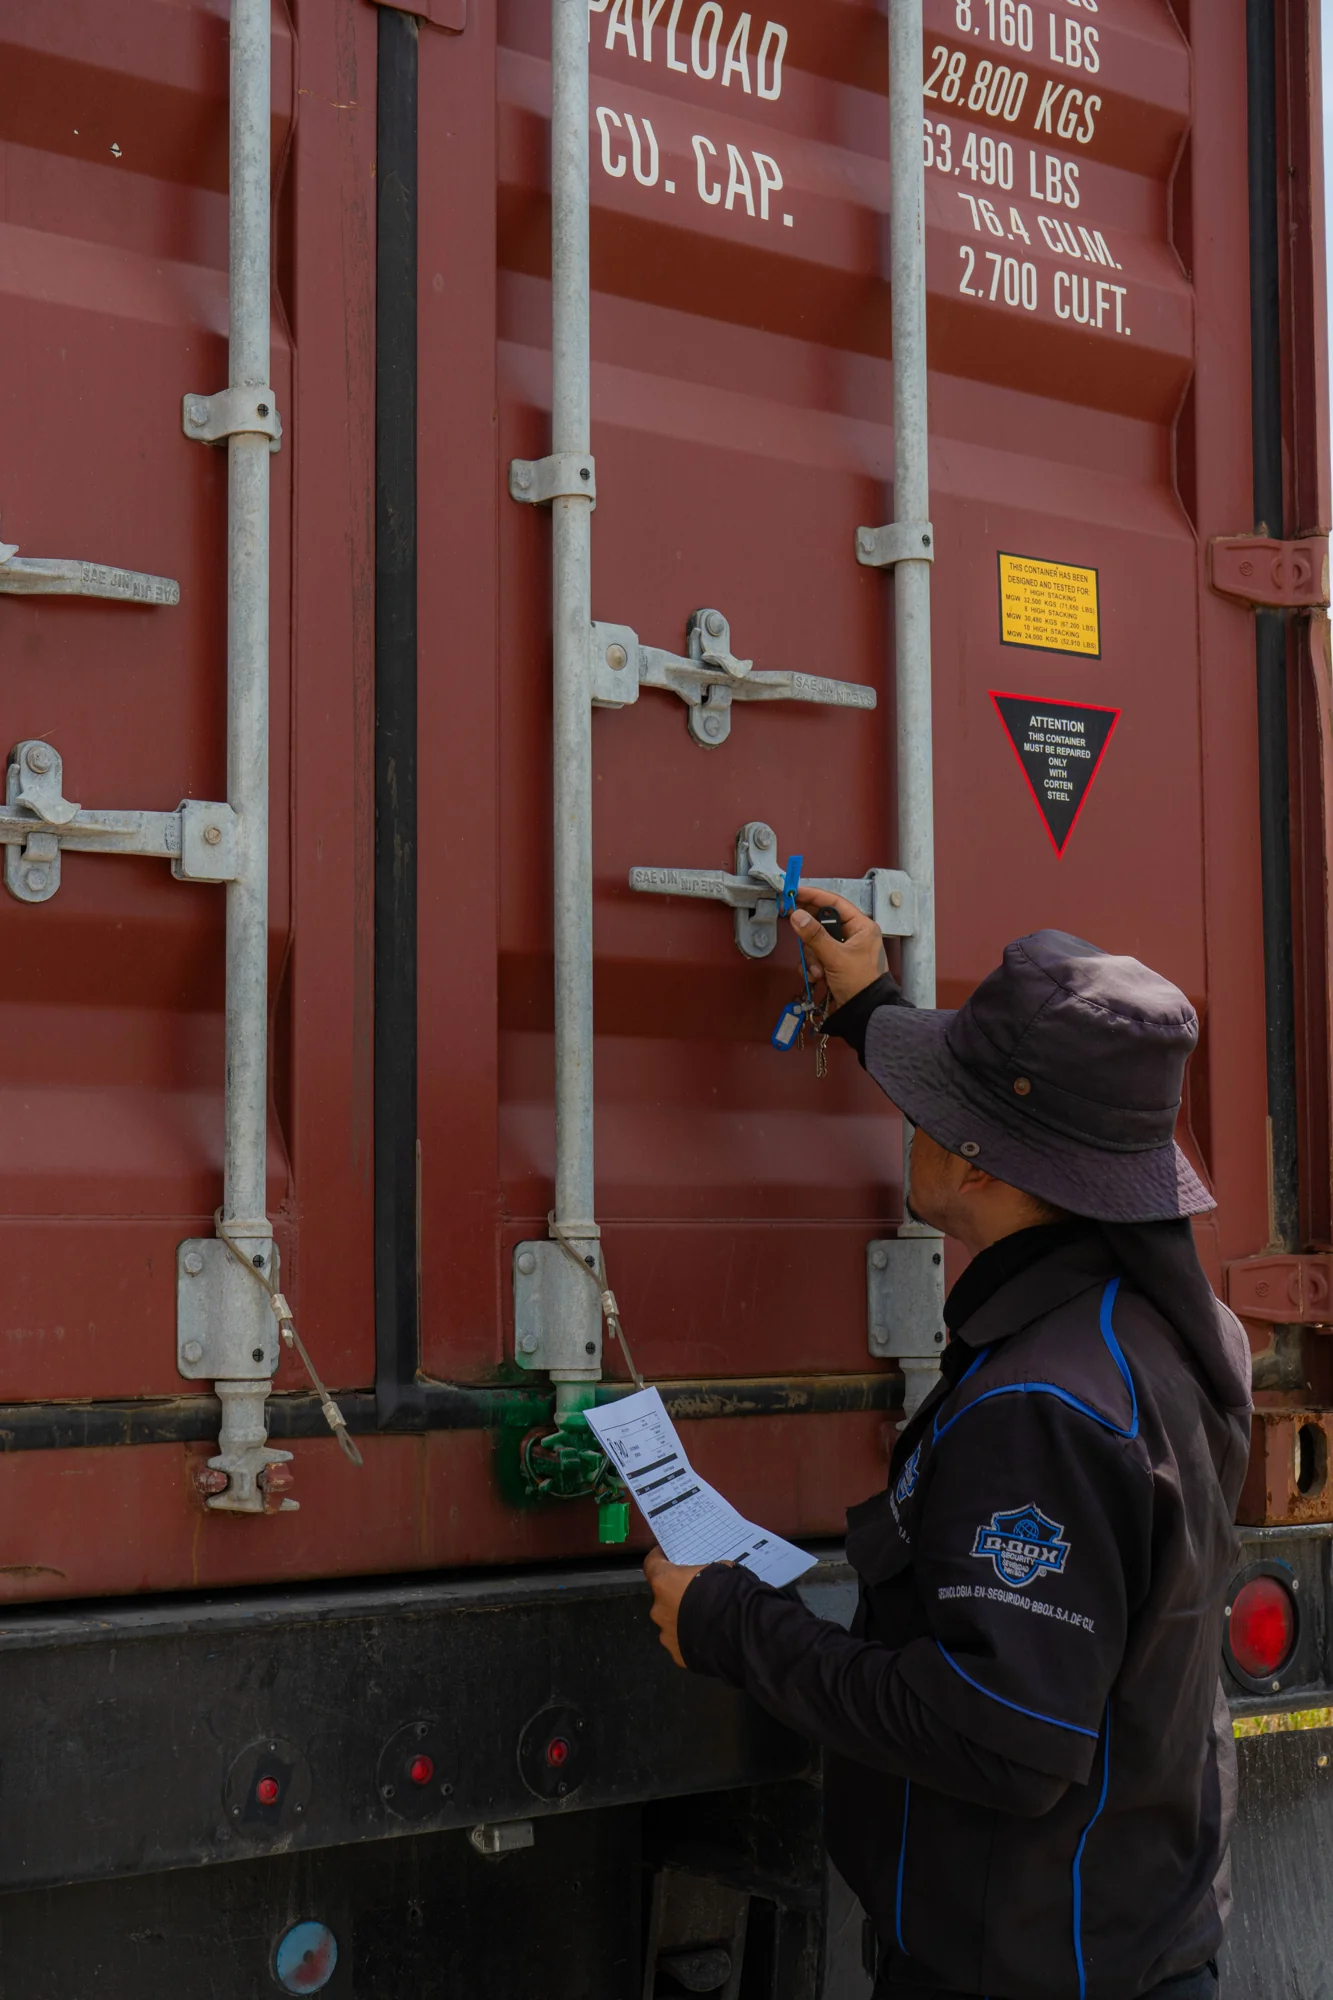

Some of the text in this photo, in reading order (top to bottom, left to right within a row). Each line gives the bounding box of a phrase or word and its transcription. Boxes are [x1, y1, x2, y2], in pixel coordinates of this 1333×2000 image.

[1049, 12, 1101, 74] LBS
[1033, 79, 1102, 145] KGS
[595, 106, 794, 228] CU. CAP.
[1029, 149, 1081, 209] LBS
[957, 191, 1123, 270] 76.4 CU.M.
[1053, 270, 1132, 336] CU.FT.
[1009, 562, 1089, 584] THIS CONTAINER HAS BEEN
[1007, 574, 1091, 596] DESIGNED AND TESTED FOR:
[1006, 593, 1021, 602] MGW
[1044, 600, 1057, 608] KGS
[1030, 589, 1045, 597] HIGH
[1047, 592, 1077, 603] STACKING
[1006, 612, 1022, 621] MGW
[1045, 618, 1058, 627] KGS
[1030, 607, 1046, 615] HIGH
[1048, 609, 1078, 620] STACKING
[1007, 629, 1022, 638] MGW
[1045, 636, 1059, 645] KGS
[1033, 625, 1048, 634] HIGH
[1050, 628, 1080, 639] STACKING
[1029, 715, 1085, 733] ATTENTION
[1028, 731, 1086, 747] THIS CONTAINER
[1023, 742, 1091, 759] MUST BE REPAIRED
[1048, 757, 1068, 767] ONLY
[1049, 768, 1068, 779] WITH
[1043, 778, 1073, 791] CORTEN
[1047, 790, 1070, 802] STEEL
[1000, 1550, 1036, 1566] SECURITY
[974, 1585, 986, 1598] EN
[987, 1587, 1031, 1610] SEGURIDAD
[1031, 1600, 1054, 1618] BBOX
[1070, 1612, 1082, 1627] DE
